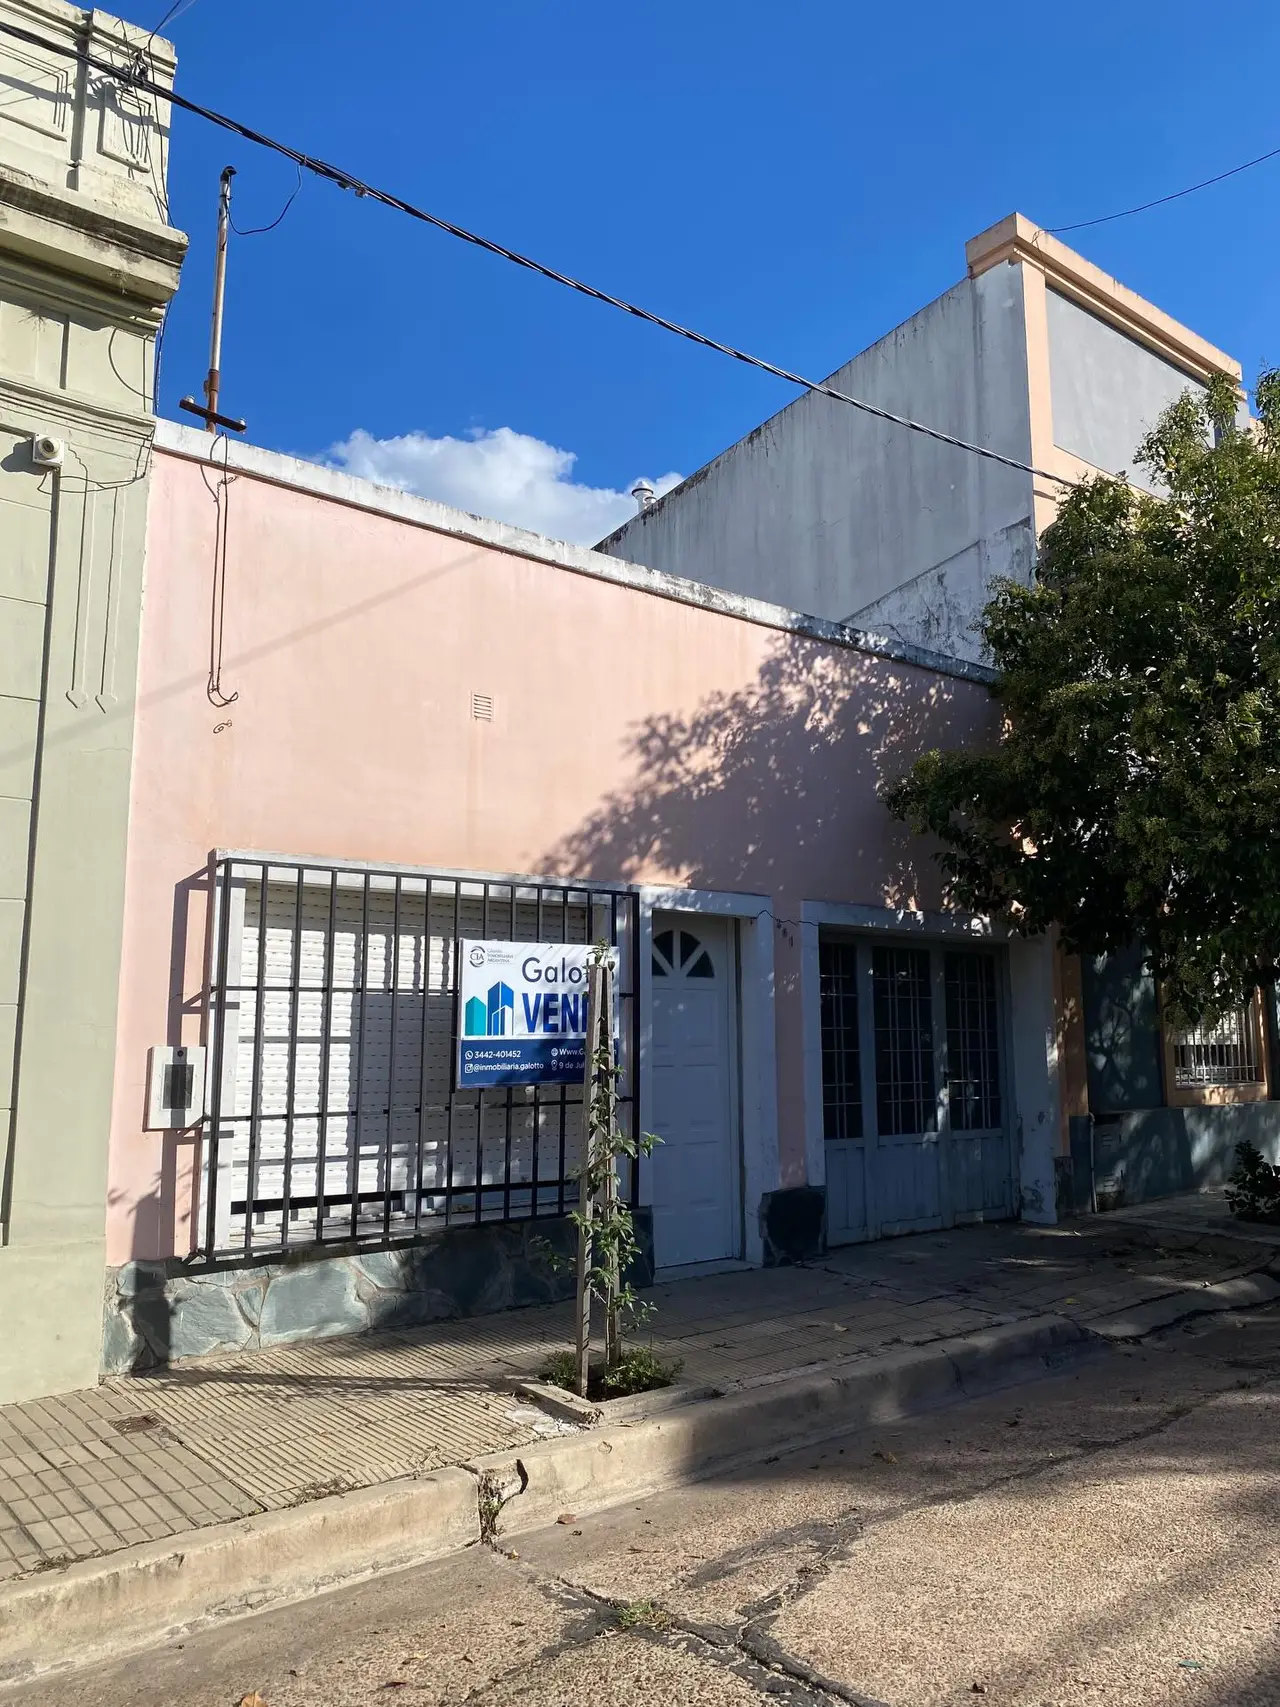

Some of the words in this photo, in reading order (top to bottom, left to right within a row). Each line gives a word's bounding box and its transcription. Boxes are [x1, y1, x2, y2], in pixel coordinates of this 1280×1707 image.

[522, 957, 615, 983] Galot
[522, 993, 615, 1032] VEN
[474, 1050, 521, 1058] 3442-401452
[473, 1062, 544, 1072] @inmobiliaria.galotto
[559, 1061, 564, 1069] 9
